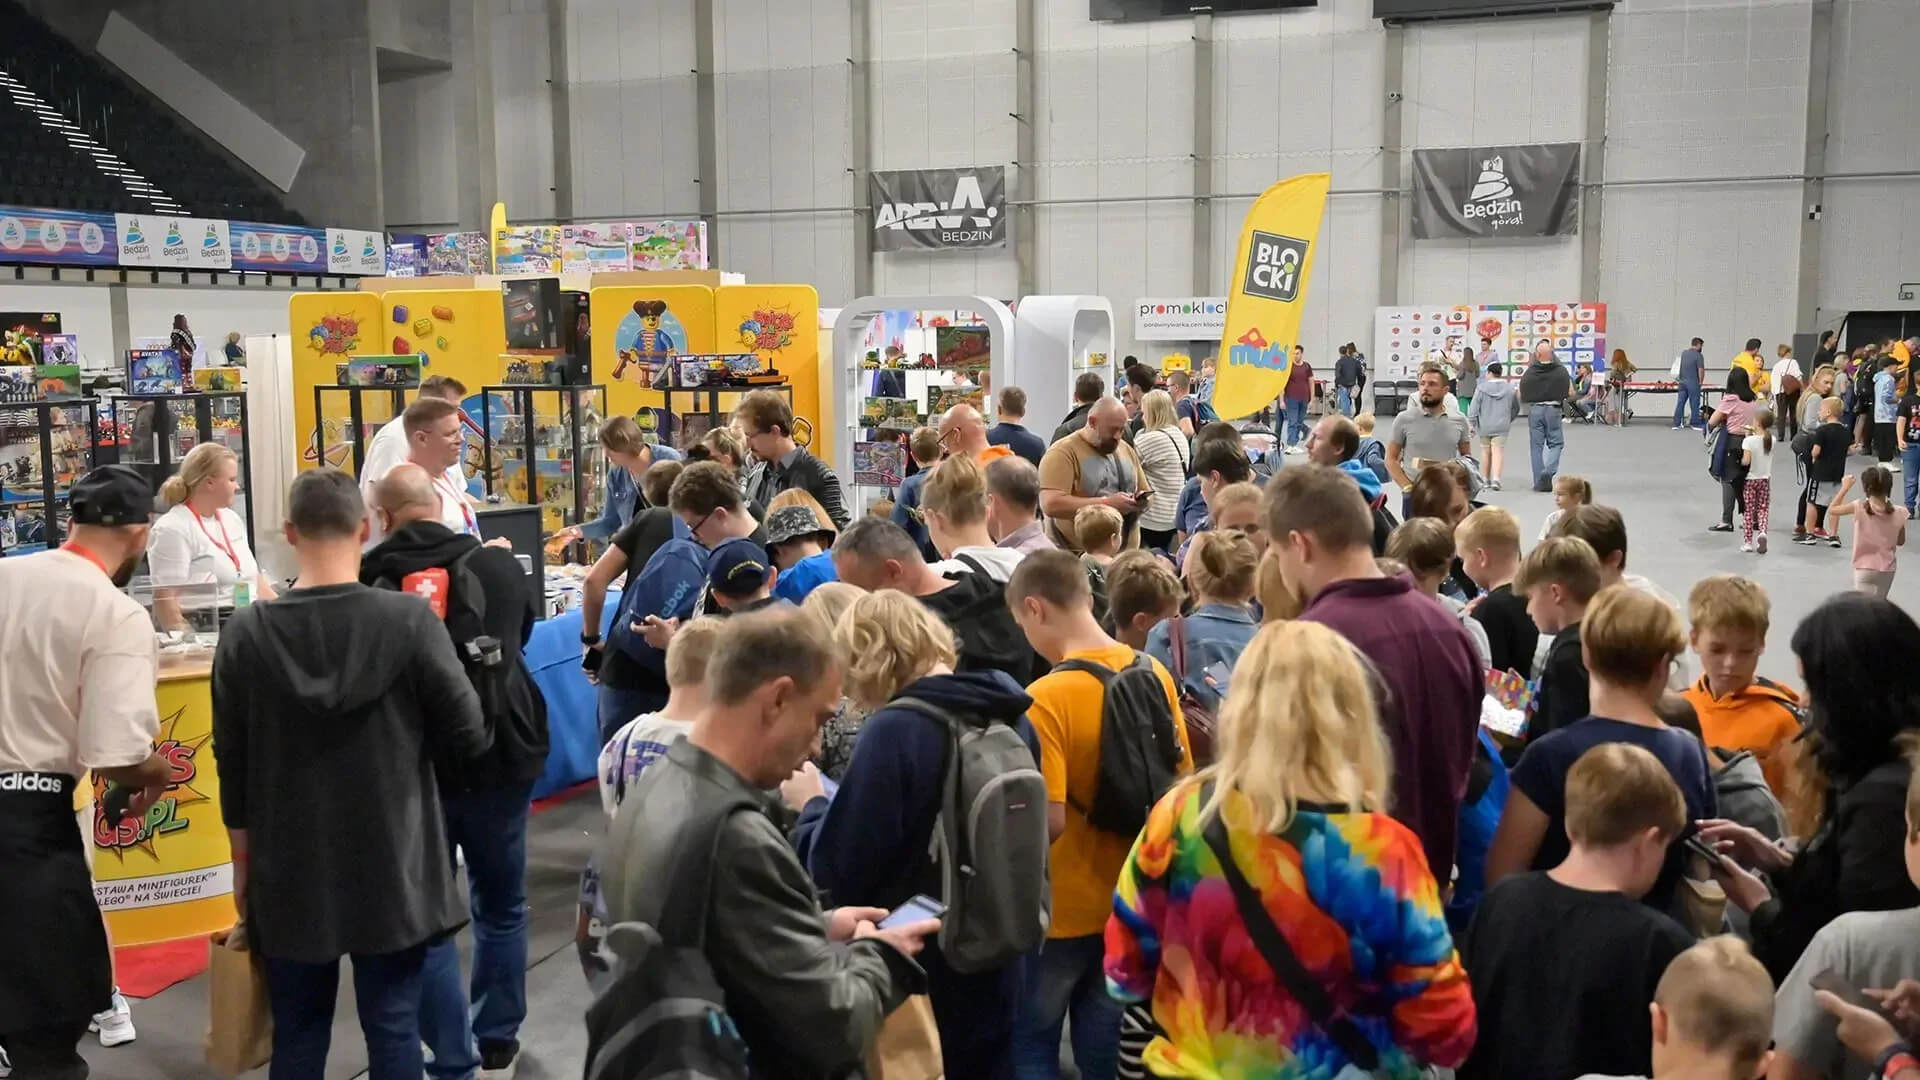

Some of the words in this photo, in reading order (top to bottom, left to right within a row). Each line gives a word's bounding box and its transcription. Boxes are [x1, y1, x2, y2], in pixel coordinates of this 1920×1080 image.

[1464, 199, 1521, 218] Będzin
[942, 231, 993, 241] BĘDZIN
[1203, 320, 1224, 328] klockó
[660, 580, 691, 618] ebok
[95, 884, 134, 896] STAWA
[135, 893, 150, 903] NA
